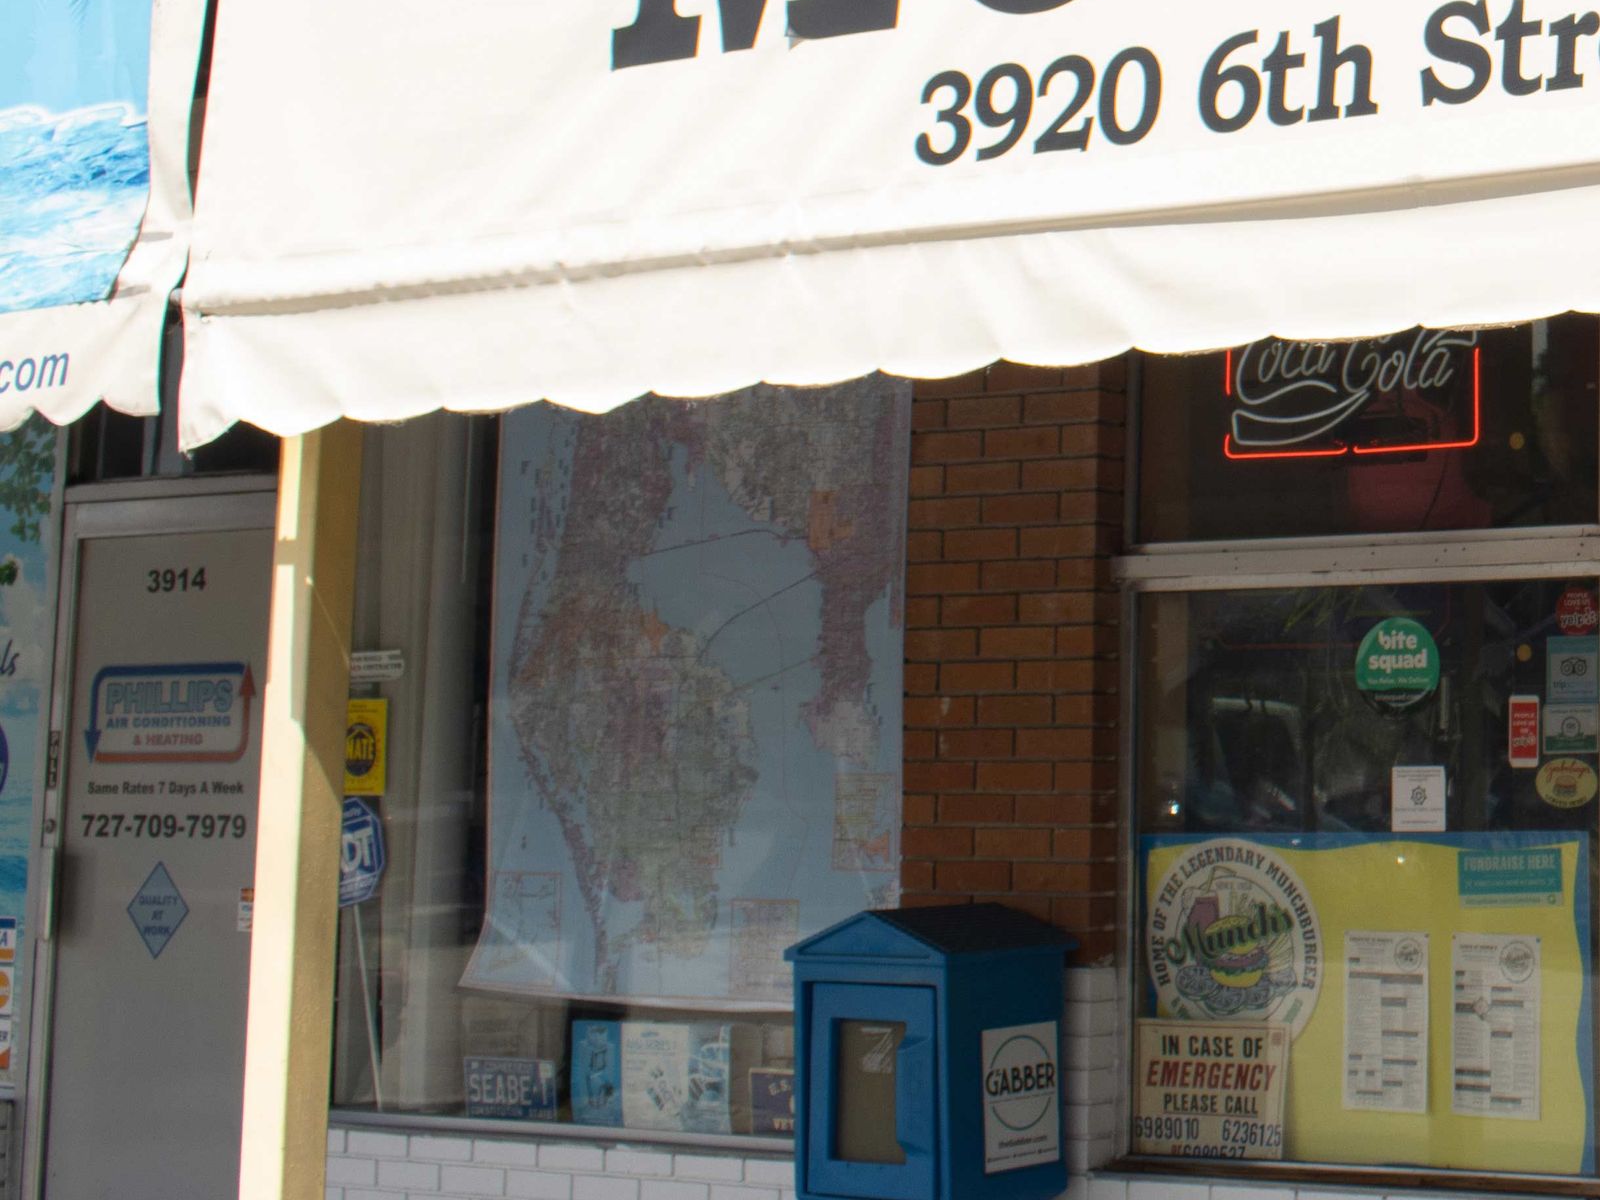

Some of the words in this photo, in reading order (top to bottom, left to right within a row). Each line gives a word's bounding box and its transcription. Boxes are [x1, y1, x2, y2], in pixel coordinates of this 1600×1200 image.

[915, 46, 1162, 167] 3920
[1199, 14, 1379, 134] 6th
[147, 568, 207, 593] 3914
[1378, 629, 1418, 650] bite
[1367, 647, 1428, 674] squad
[105, 678, 234, 715] PHILLIPS
[105, 717, 129, 730] AIR
[132, 715, 232, 728] CONDITIONING
[145, 732, 204, 746] HEATING
[87, 781, 119, 795] Same
[122, 781, 154, 794] Rates
[158, 781, 166, 794] 7
[168, 781, 197, 798] Days
[199, 781, 209, 794] A
[211, 780, 244, 795] Week
[81, 813, 248, 839] 727-709-7979
[1179, 845, 1266, 879] LEGENDARY
[1463, 855, 1526, 872] FUNDRAISE
[1527, 853, 1556, 870] HERE
[138, 895, 178, 906] QUALITY
[1158, 873, 1184, 906] THE
[1152, 909, 1168, 931] OF
[1166, 900, 1295, 965] Munch's
[1265, 860, 1319, 990] MUNCHBURGER
[1151, 935, 1171, 987] HOME
[1161, 1034, 1180, 1056] IN
[1188, 1035, 1235, 1058] CASE
[1242, 1037, 1264, 1059] OF
[985, 1061, 1056, 1097] GABBER
[1146, 1059, 1278, 1092] EMERGENCY
[1163, 1092, 1218, 1113] PLEASE
[1224, 1095, 1259, 1115] CALL
[1135, 1115, 1200, 1140] 6989010
[1222, 1119, 1282, 1147] 6236125
